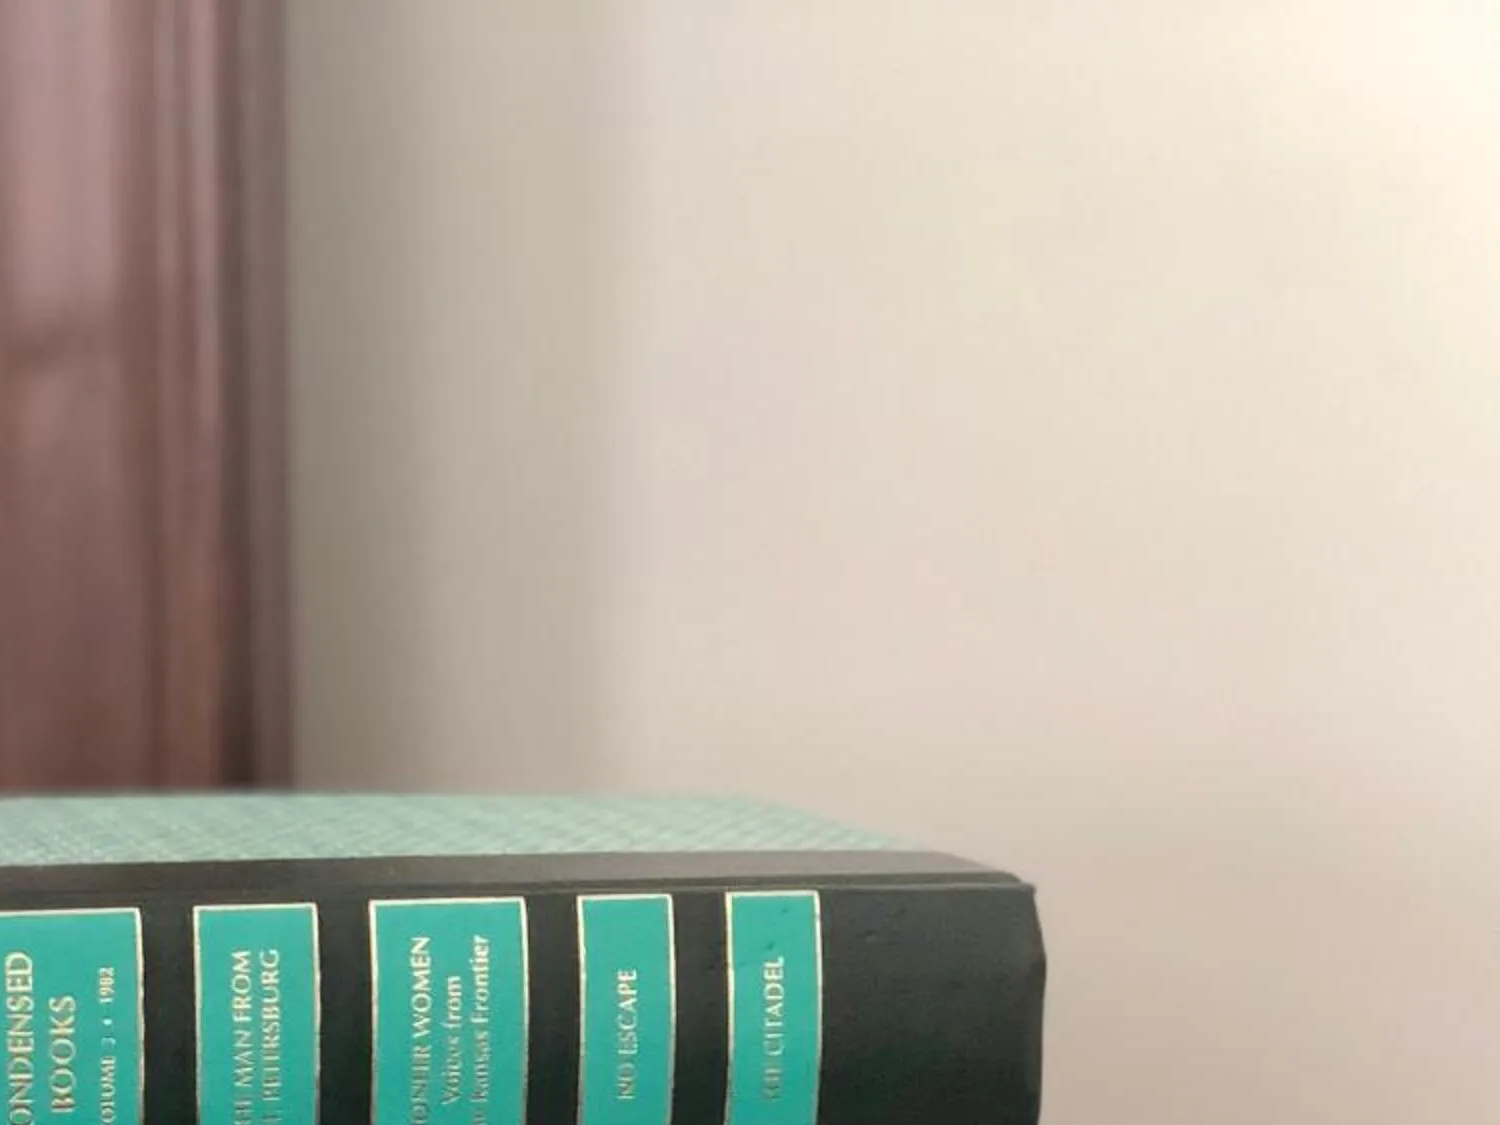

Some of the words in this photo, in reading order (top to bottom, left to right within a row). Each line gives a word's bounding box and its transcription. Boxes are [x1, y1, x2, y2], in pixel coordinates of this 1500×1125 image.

[231, 950, 252, 1022] FROM
[410, 936, 432, 1038] WOMEN
[440, 975, 462, 1029] from
[468, 935, 490, 1025] Frontier
[616, 968, 638, 1057] ESCAPE
[764, 955, 786, 1057] CITADEL
[48, 994, 77, 1114] BOOKS
[232, 1030, 253, 1087] MAN
